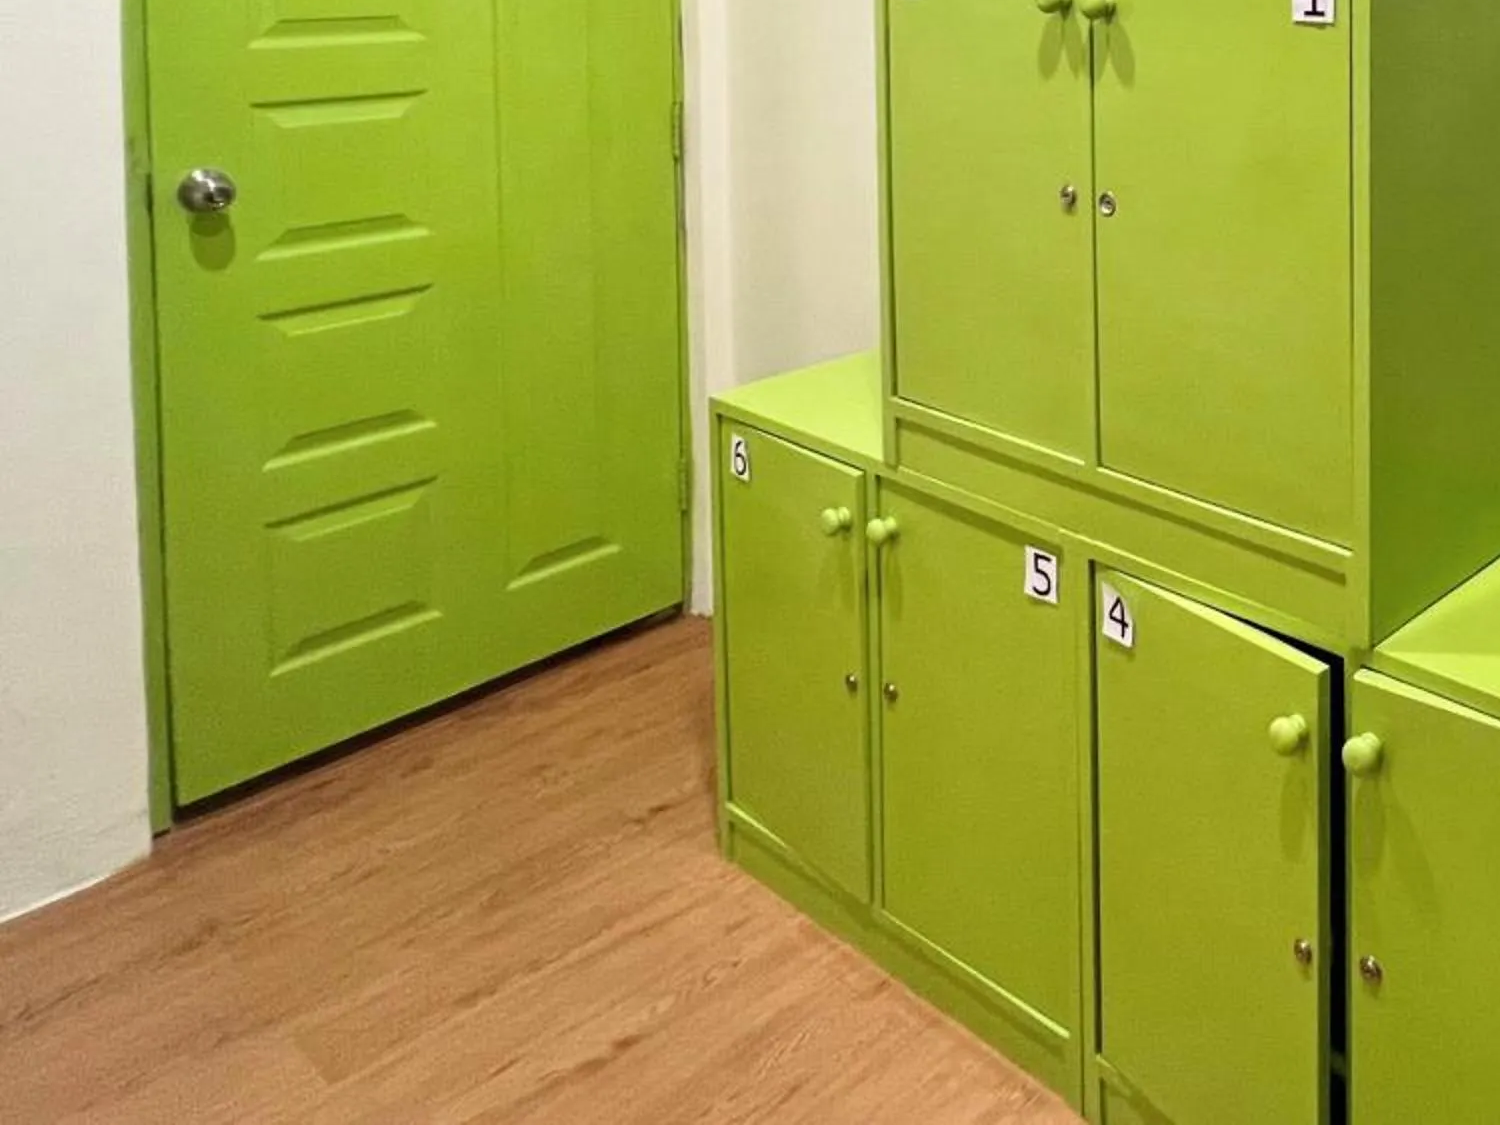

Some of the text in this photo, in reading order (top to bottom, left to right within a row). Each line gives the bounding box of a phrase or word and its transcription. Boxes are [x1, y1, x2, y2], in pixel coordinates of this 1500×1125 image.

[734, 440, 747, 476] 6
[1032, 552, 1053, 596] 5
[1108, 596, 1129, 639] 4
